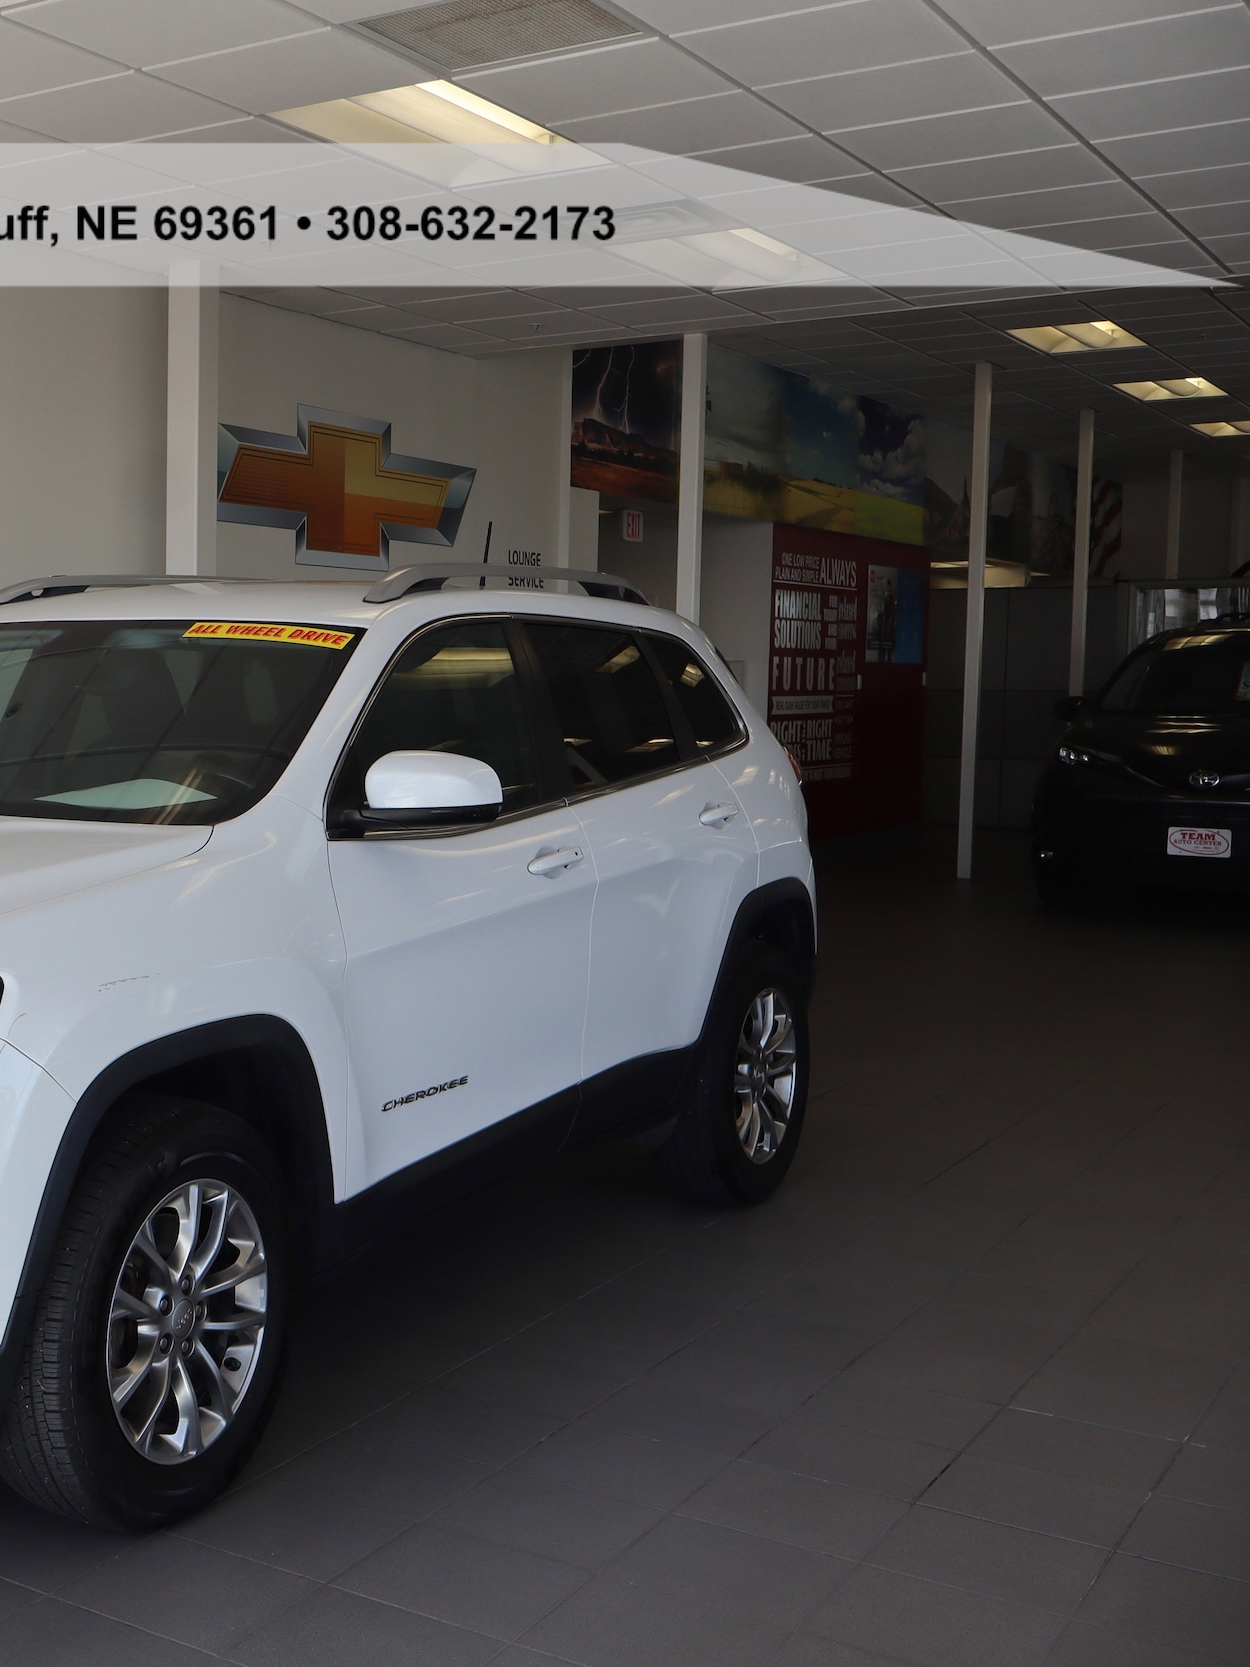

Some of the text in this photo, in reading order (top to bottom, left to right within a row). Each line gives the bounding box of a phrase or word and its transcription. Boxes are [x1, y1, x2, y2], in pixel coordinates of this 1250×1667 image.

[626, 512, 641, 539] EXIT
[508, 549, 541, 567] LOUNGE
[781, 552, 820, 569] ONE LOW PRICE
[508, 576, 544, 589] SERVICE
[775, 566, 819, 583] PLAIN AND SIMPLE
[819, 557, 857, 587] ALWAYS
[775, 589, 822, 621] FINANCIAL
[187, 624, 351, 646] ALL WHEEL DRIVE
[774, 619, 822, 650] SOLUTIONS
[772, 656, 836, 691] FUTURE
[770, 720, 803, 743] RIGHT
[806, 719, 833, 739] RIGHT
[806, 738, 832, 761] TIME
[1180, 832, 1216, 841] TEAM
[381, 1075, 469, 1112] CHEROKEE
